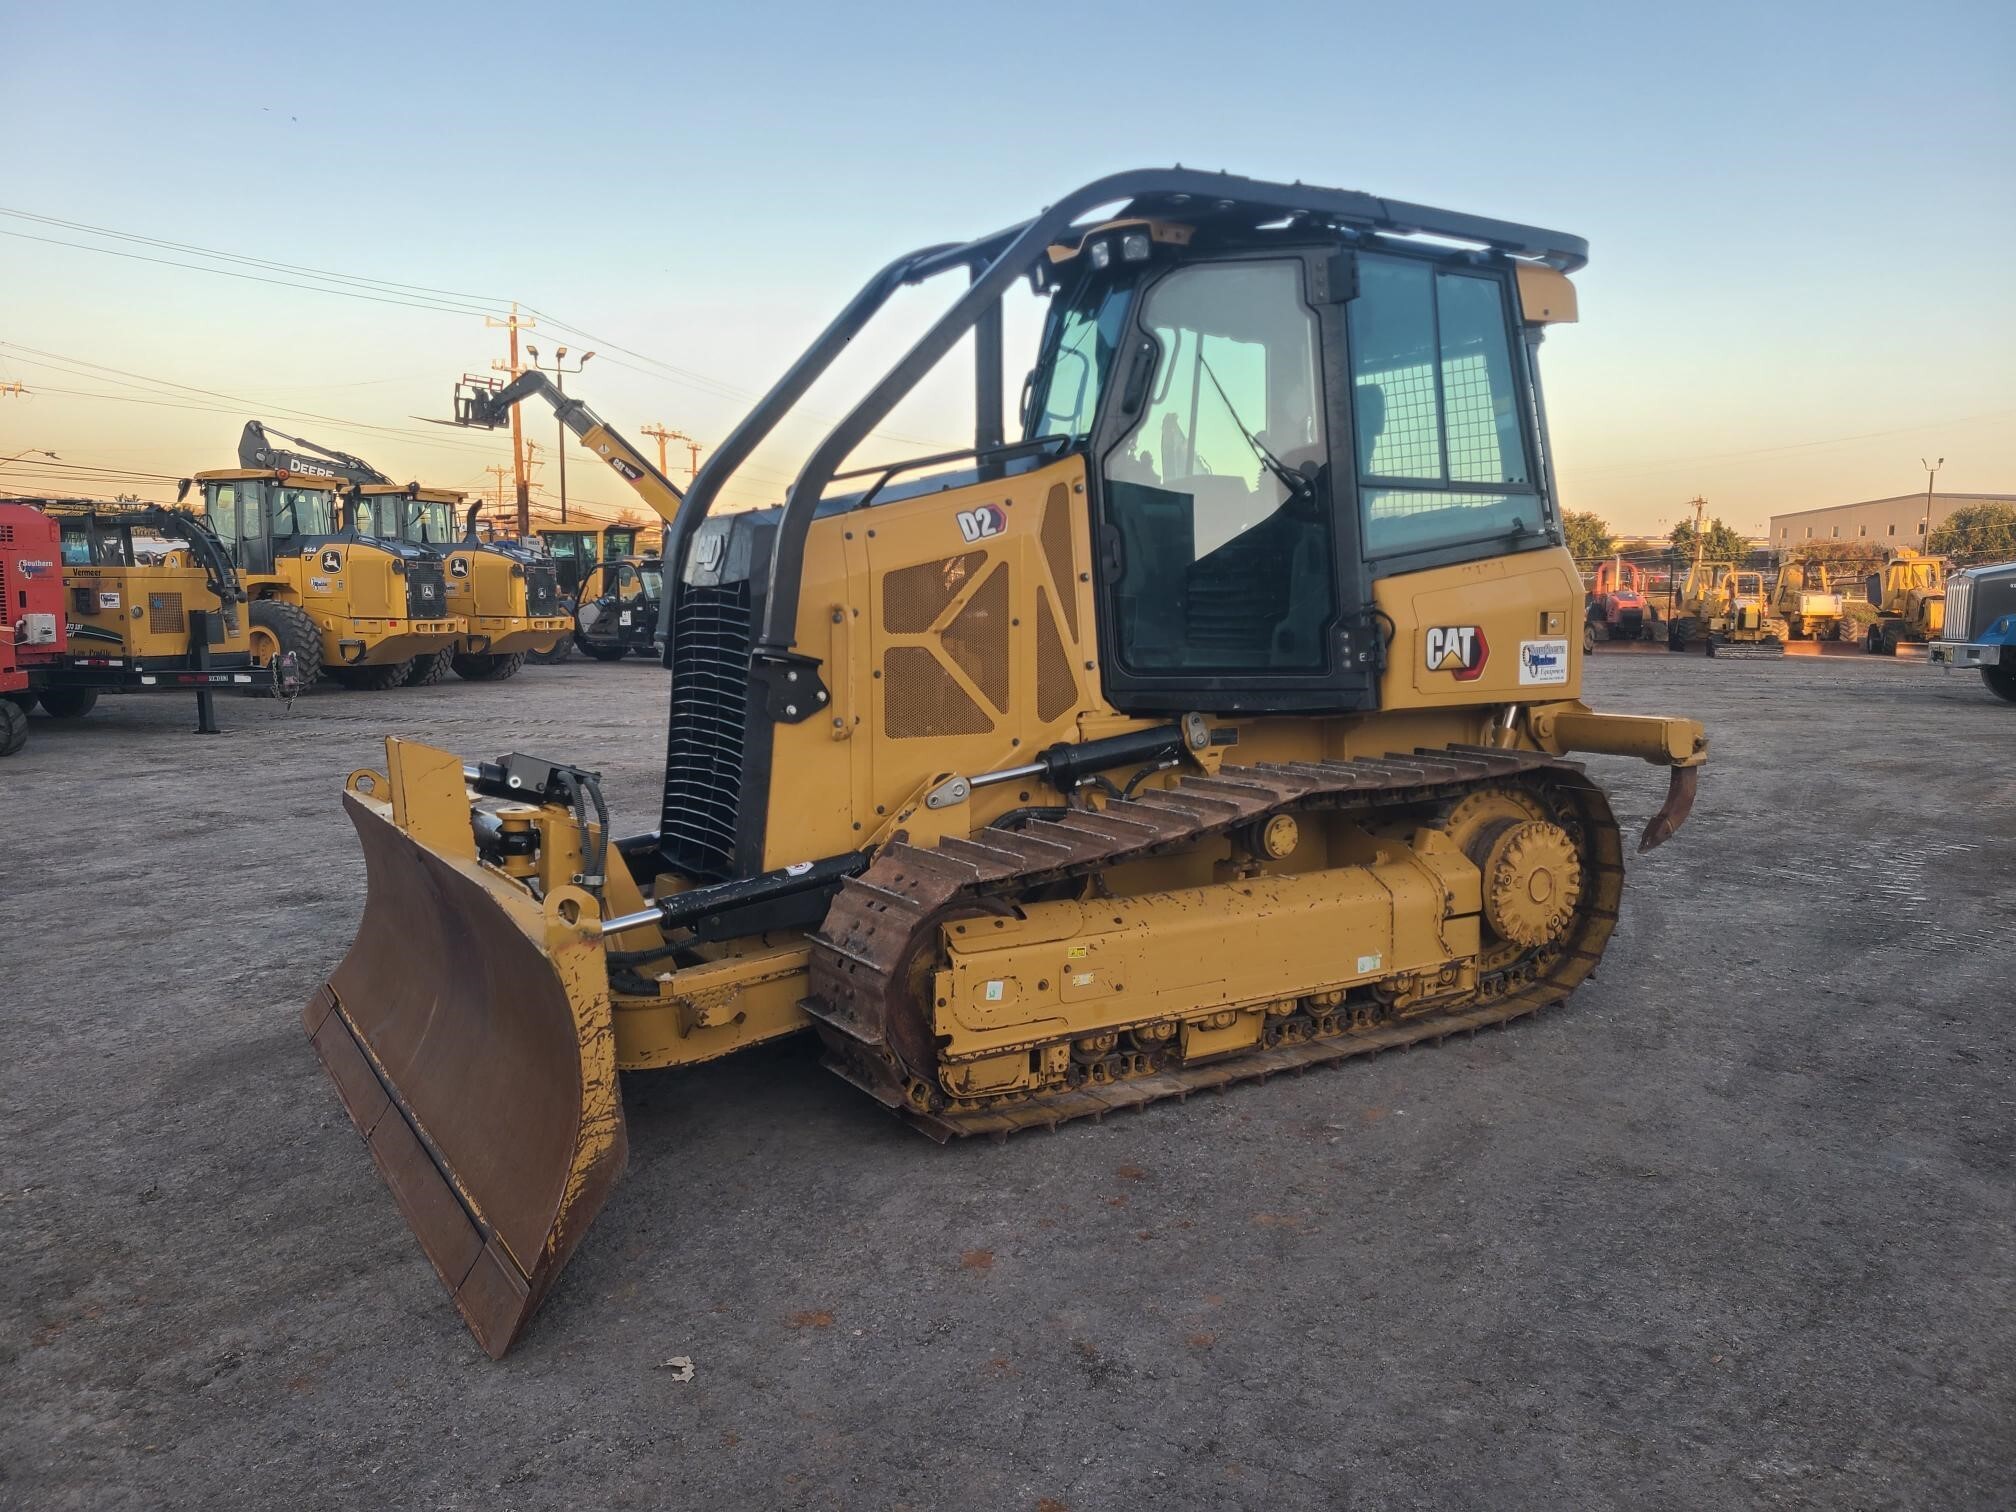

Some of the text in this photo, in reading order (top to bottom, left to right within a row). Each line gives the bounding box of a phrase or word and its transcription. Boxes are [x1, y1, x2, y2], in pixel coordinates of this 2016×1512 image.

[290, 459, 335, 477] DEERE
[957, 507, 997, 541] D2
[73, 568, 101, 577] Vermeer
[1427, 627, 1474, 670] CAT
